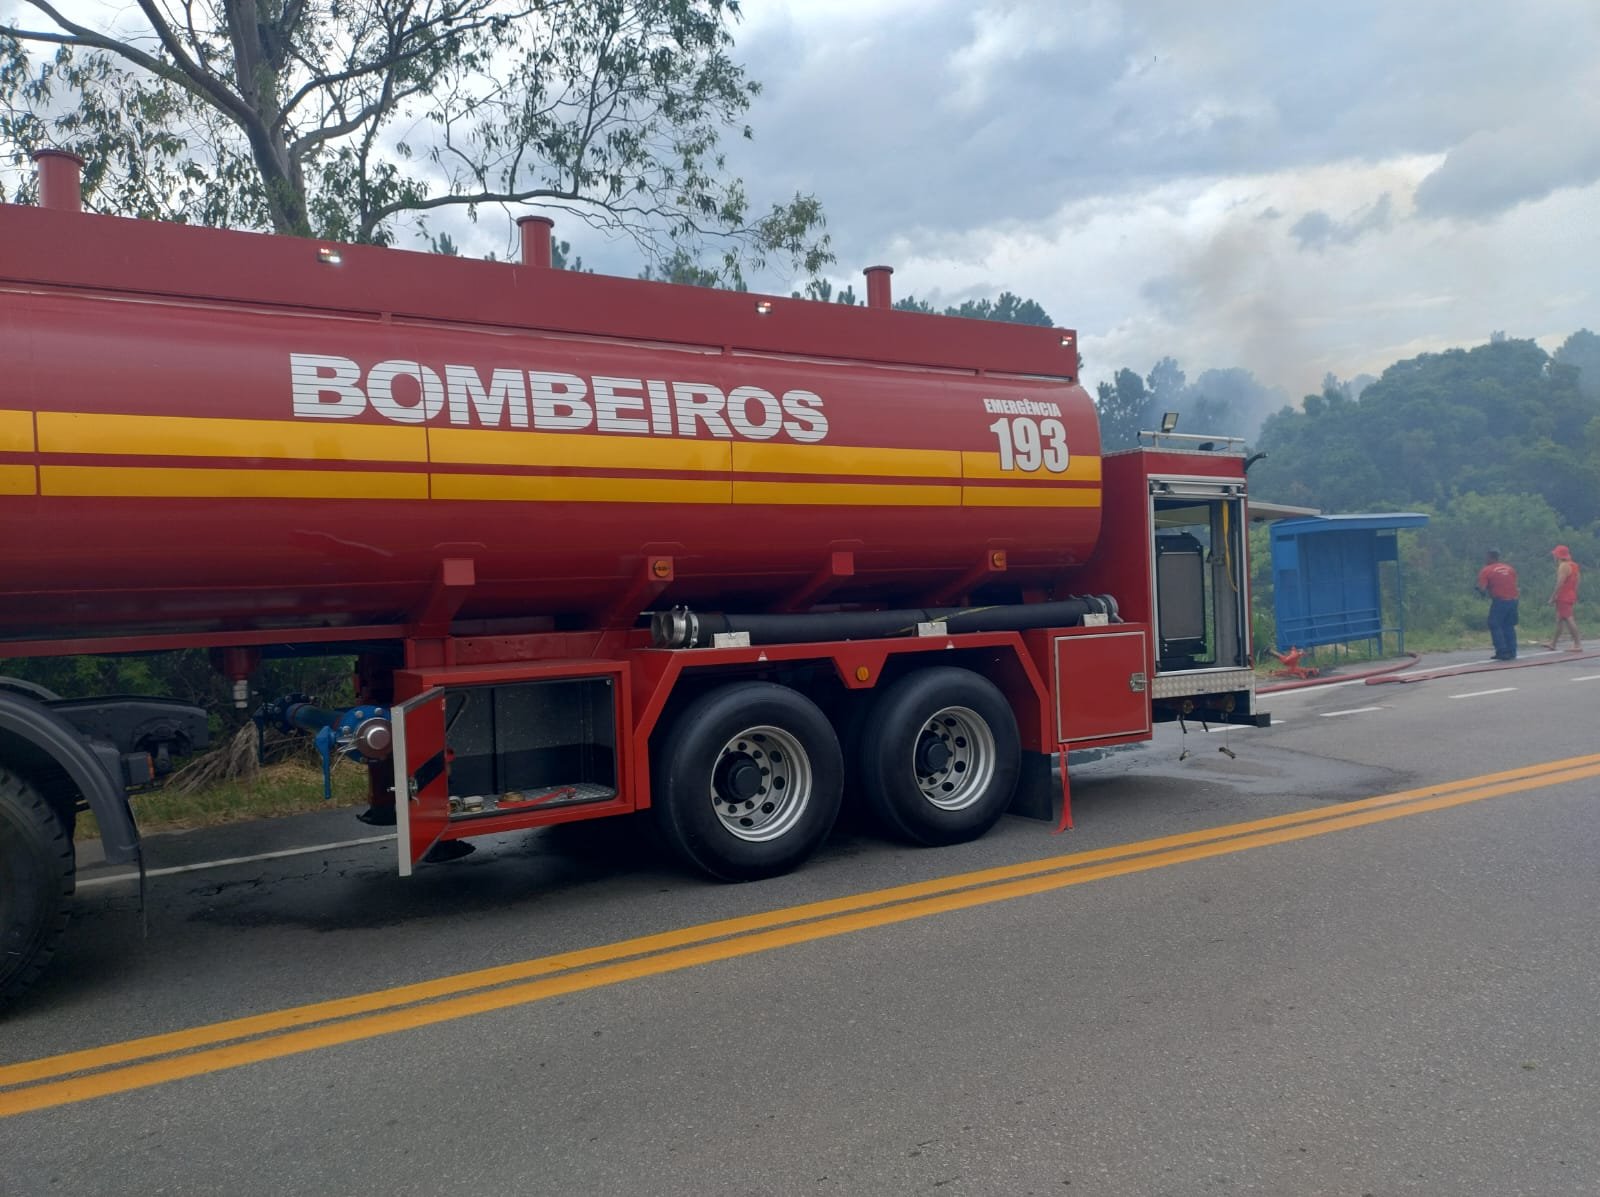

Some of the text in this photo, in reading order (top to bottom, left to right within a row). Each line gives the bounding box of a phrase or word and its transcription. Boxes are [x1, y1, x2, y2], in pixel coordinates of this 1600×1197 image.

[290, 353, 829, 442] BOMBEIROS
[983, 398, 1062, 417] EMERGÊNCIA
[989, 417, 1070, 473] 193
